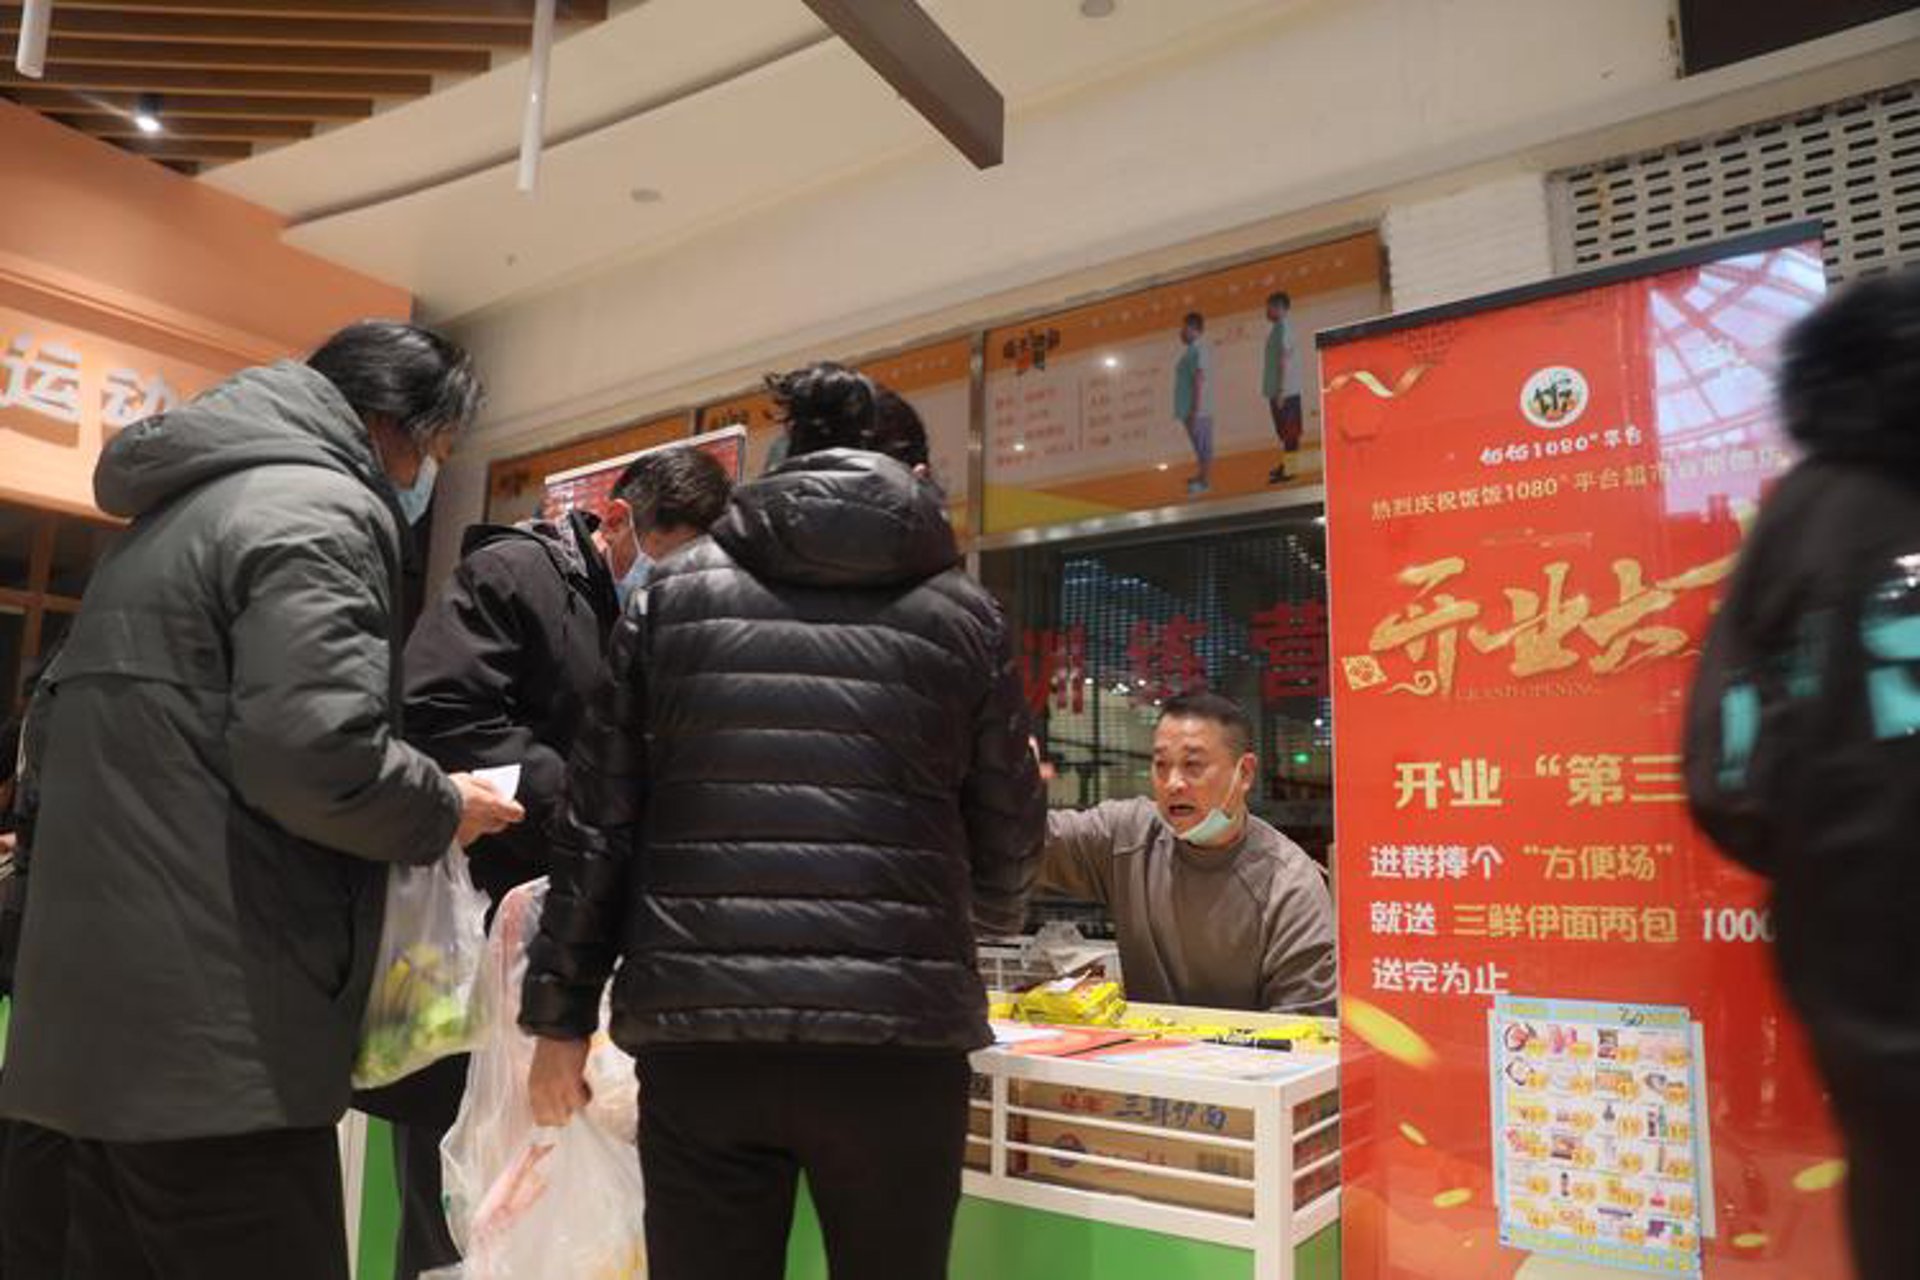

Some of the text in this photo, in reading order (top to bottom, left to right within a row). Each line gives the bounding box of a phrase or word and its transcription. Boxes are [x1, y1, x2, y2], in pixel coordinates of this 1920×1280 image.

[1368, 550, 1741, 698] 开业大
[1393, 758, 1502, 810] 开业
[1370, 900, 1436, 936] 就送
[1453, 903, 1678, 943] 三鲜伊面两包
[1371, 957, 1509, 996] 送完为止
